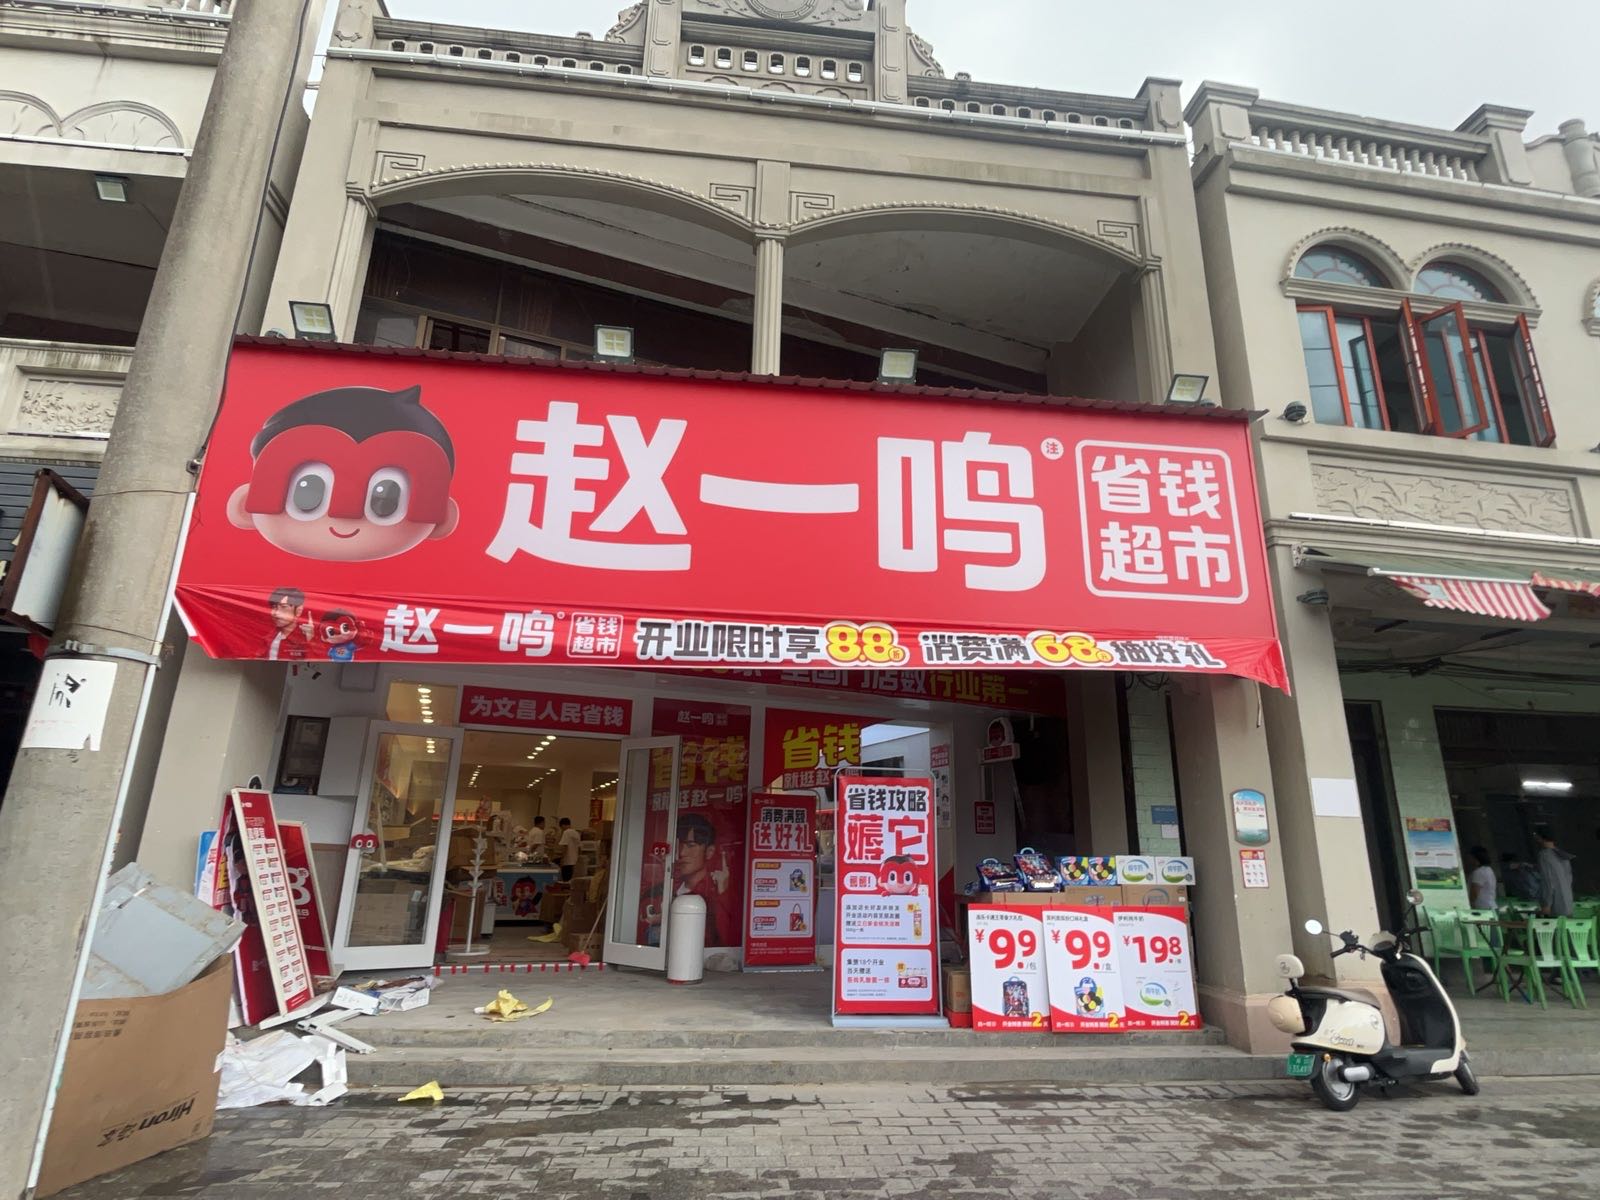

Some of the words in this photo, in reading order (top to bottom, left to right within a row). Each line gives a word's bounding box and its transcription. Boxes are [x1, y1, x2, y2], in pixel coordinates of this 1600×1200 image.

[486, 401, 1047, 591] 赵一鸣
[1091, 454, 1222, 520] 省钱
[1100, 522, 1231, 588] 超市
[380, 604, 554, 657] 赵一鸣
[574, 616, 619, 636] 省钱
[573, 637, 618, 655] 超市
[469, 695, 625, 727] 为文昌人民省钱
[677, 711, 714, 725] 赵一鸣
[783, 722, 862, 769] 省钱
[848, 788, 927, 811] 省钱攻略
[763, 809, 806, 823] 消费满额
[754, 823, 812, 851] 送好礼
[138, 1098, 195, 1131] Hiron
